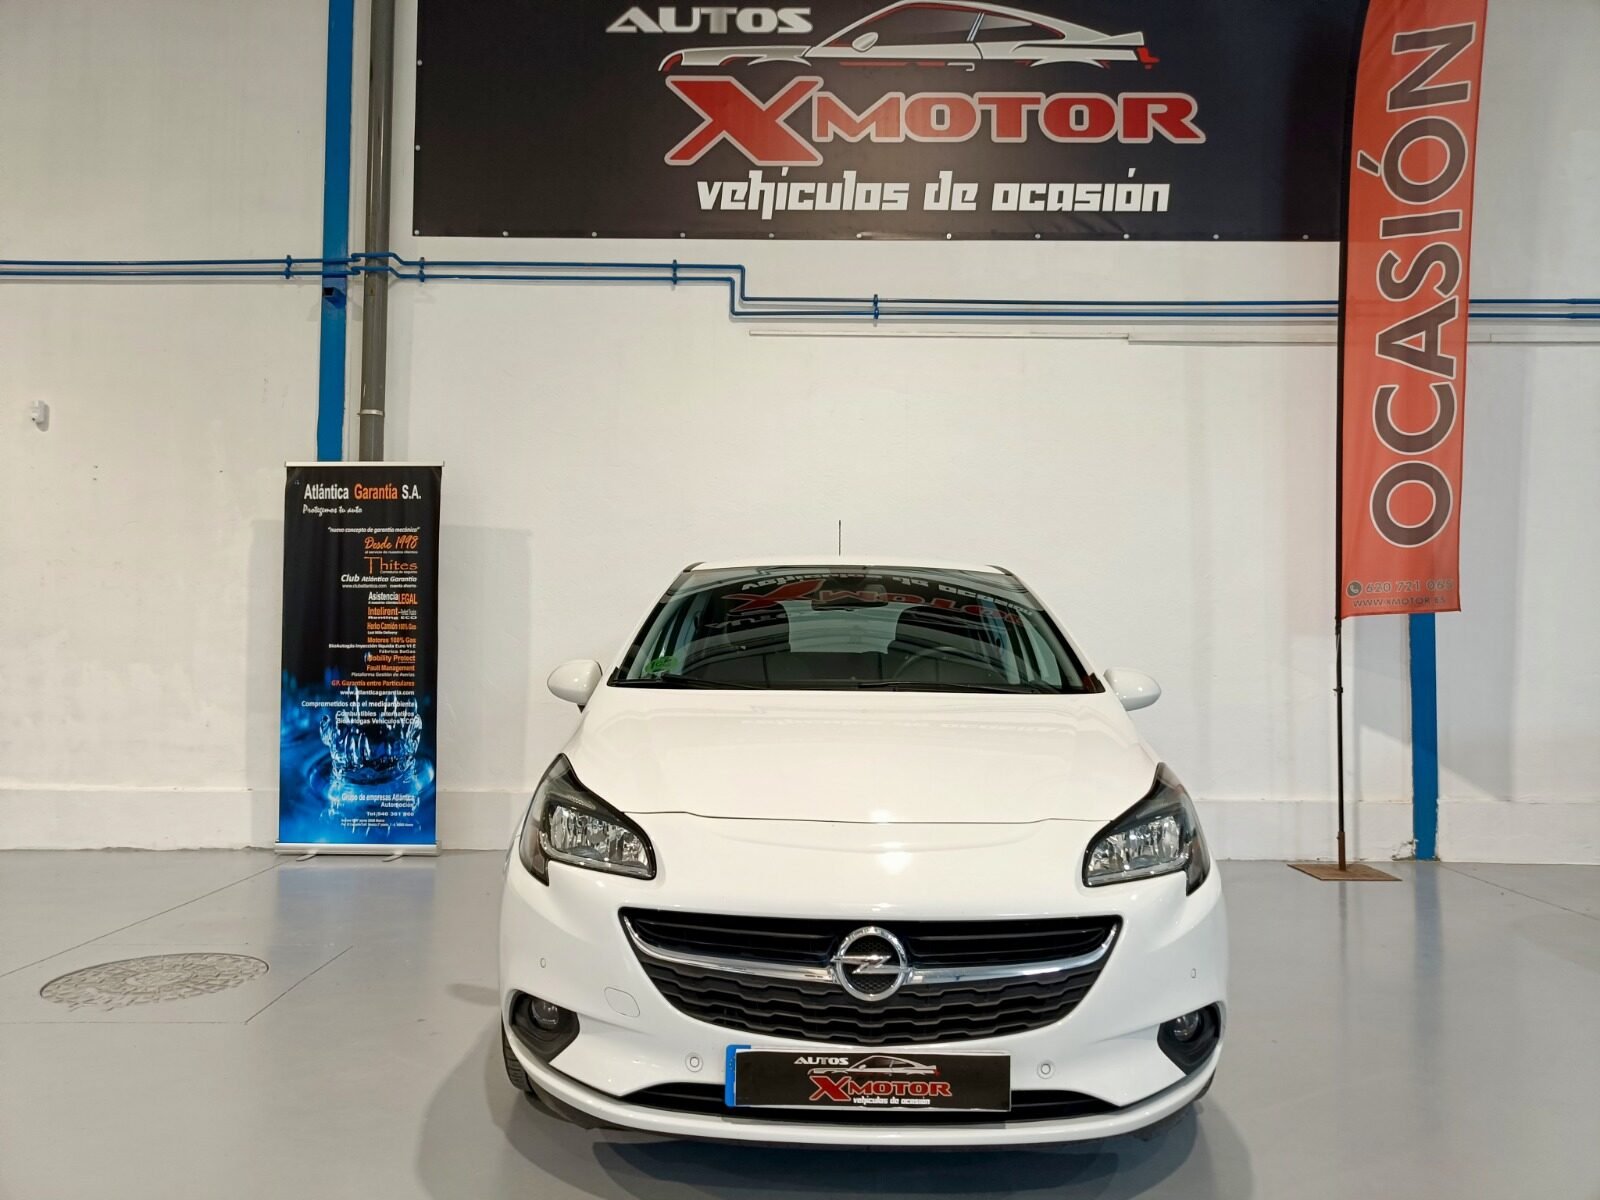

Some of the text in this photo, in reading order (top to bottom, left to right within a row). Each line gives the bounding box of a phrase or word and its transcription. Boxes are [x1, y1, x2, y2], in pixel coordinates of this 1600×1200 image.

[605, 6, 814, 34] AUTOS
[664, 75, 1207, 167] XMOTOR
[923, 171, 978, 212] de
[991, 169, 1170, 212] ocasión
[1356, 21, 1476, 548] OCASIÓN
[303, 483, 422, 500] Atlántica Garantía S.A.
[364, 535, 419, 550] Desde 1998
[340, 573, 360, 582] Club
[398, 593, 417, 605] LEGAL
[793, 1056, 849, 1066] AUTOS
[808, 1075, 953, 1102] XMOTOR
